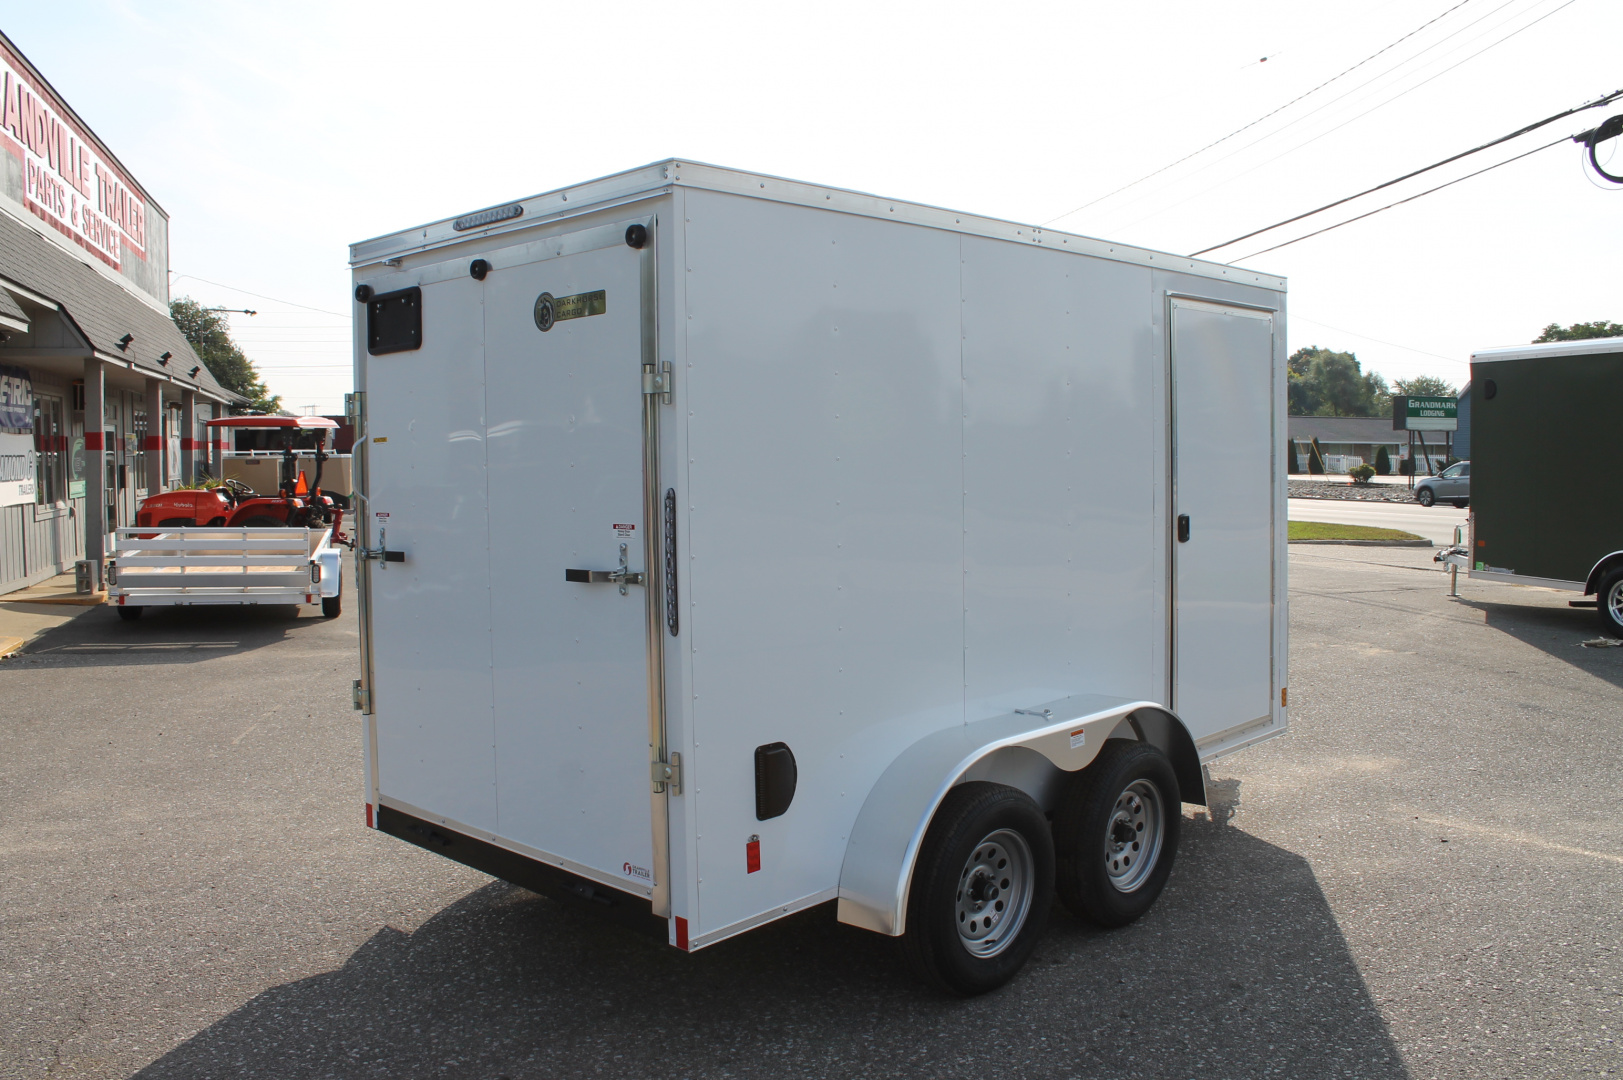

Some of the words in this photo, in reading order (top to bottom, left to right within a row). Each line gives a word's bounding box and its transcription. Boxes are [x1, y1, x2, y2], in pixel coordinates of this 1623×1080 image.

[0, 71, 91, 200] ANDVILLE
[94, 162, 145, 247] TRAILER
[27, 157, 66, 219] PARTS
[71, 193, 78, 228] &
[82, 204, 120, 260] SERVICE
[556, 293, 604, 308] DARKHORSE
[556, 307, 583, 319] CARGO
[1420, 409, 1445, 417] LODGING
